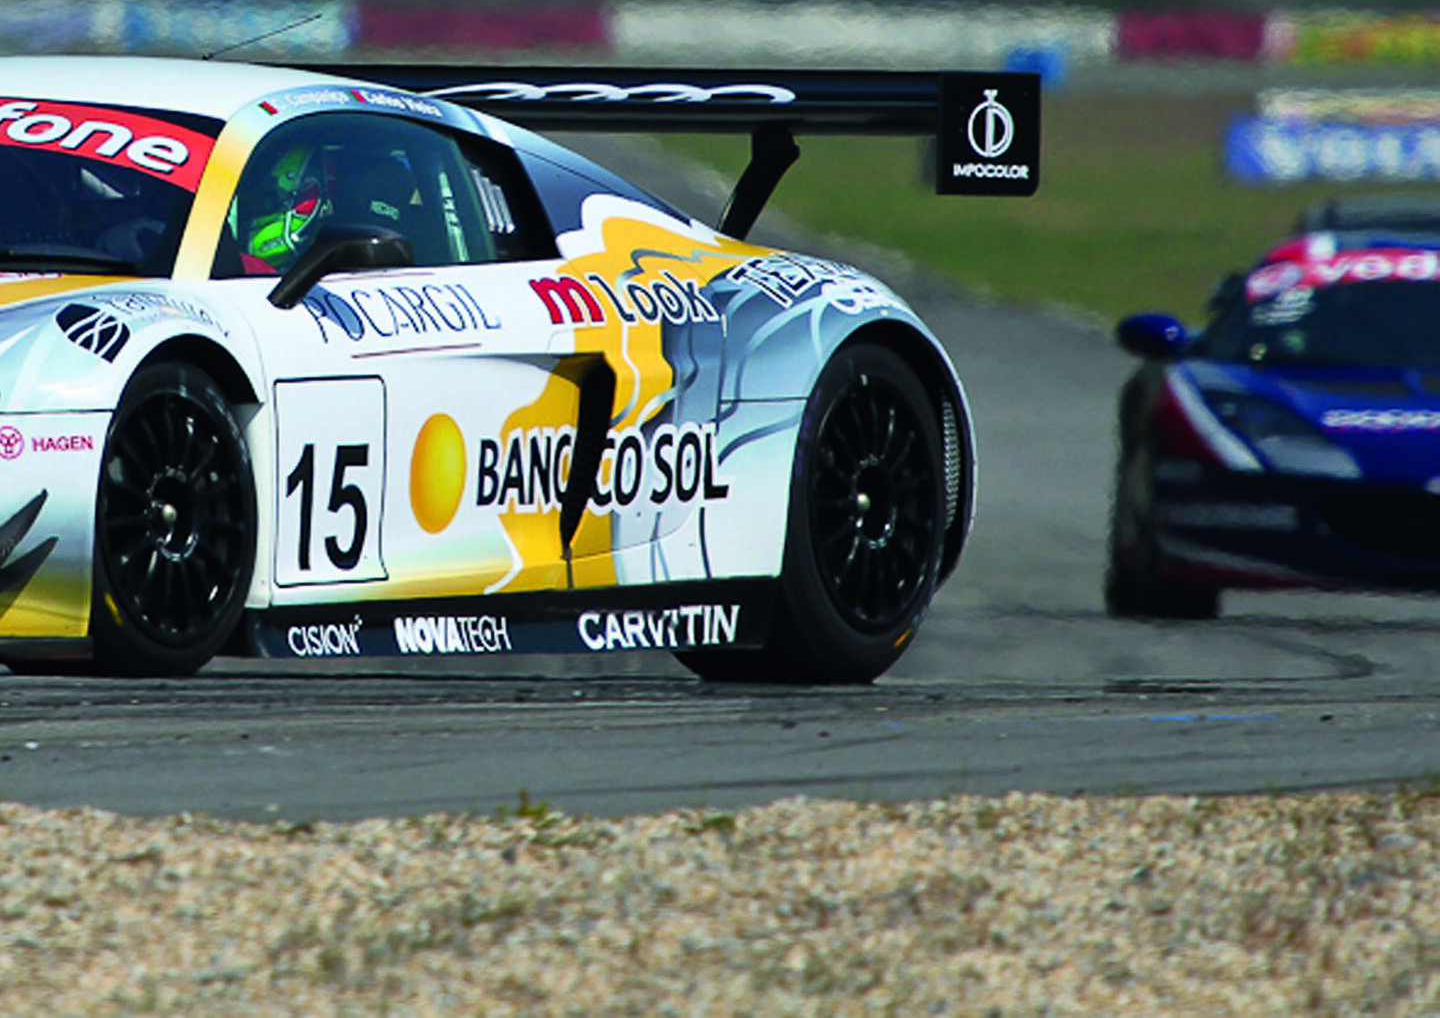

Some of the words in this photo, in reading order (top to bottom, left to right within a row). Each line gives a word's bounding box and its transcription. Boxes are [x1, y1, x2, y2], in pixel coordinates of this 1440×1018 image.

[953, 164, 1030, 179] IMPOCOLOR
[299, 284, 503, 343] POCARGIL
[32, 436, 94, 452] HAGEN
[649, 430, 730, 505] SOL
[285, 443, 370, 571] 15
[287, 623, 361, 657] CISION
[394, 615, 513, 655] NOVATECH
